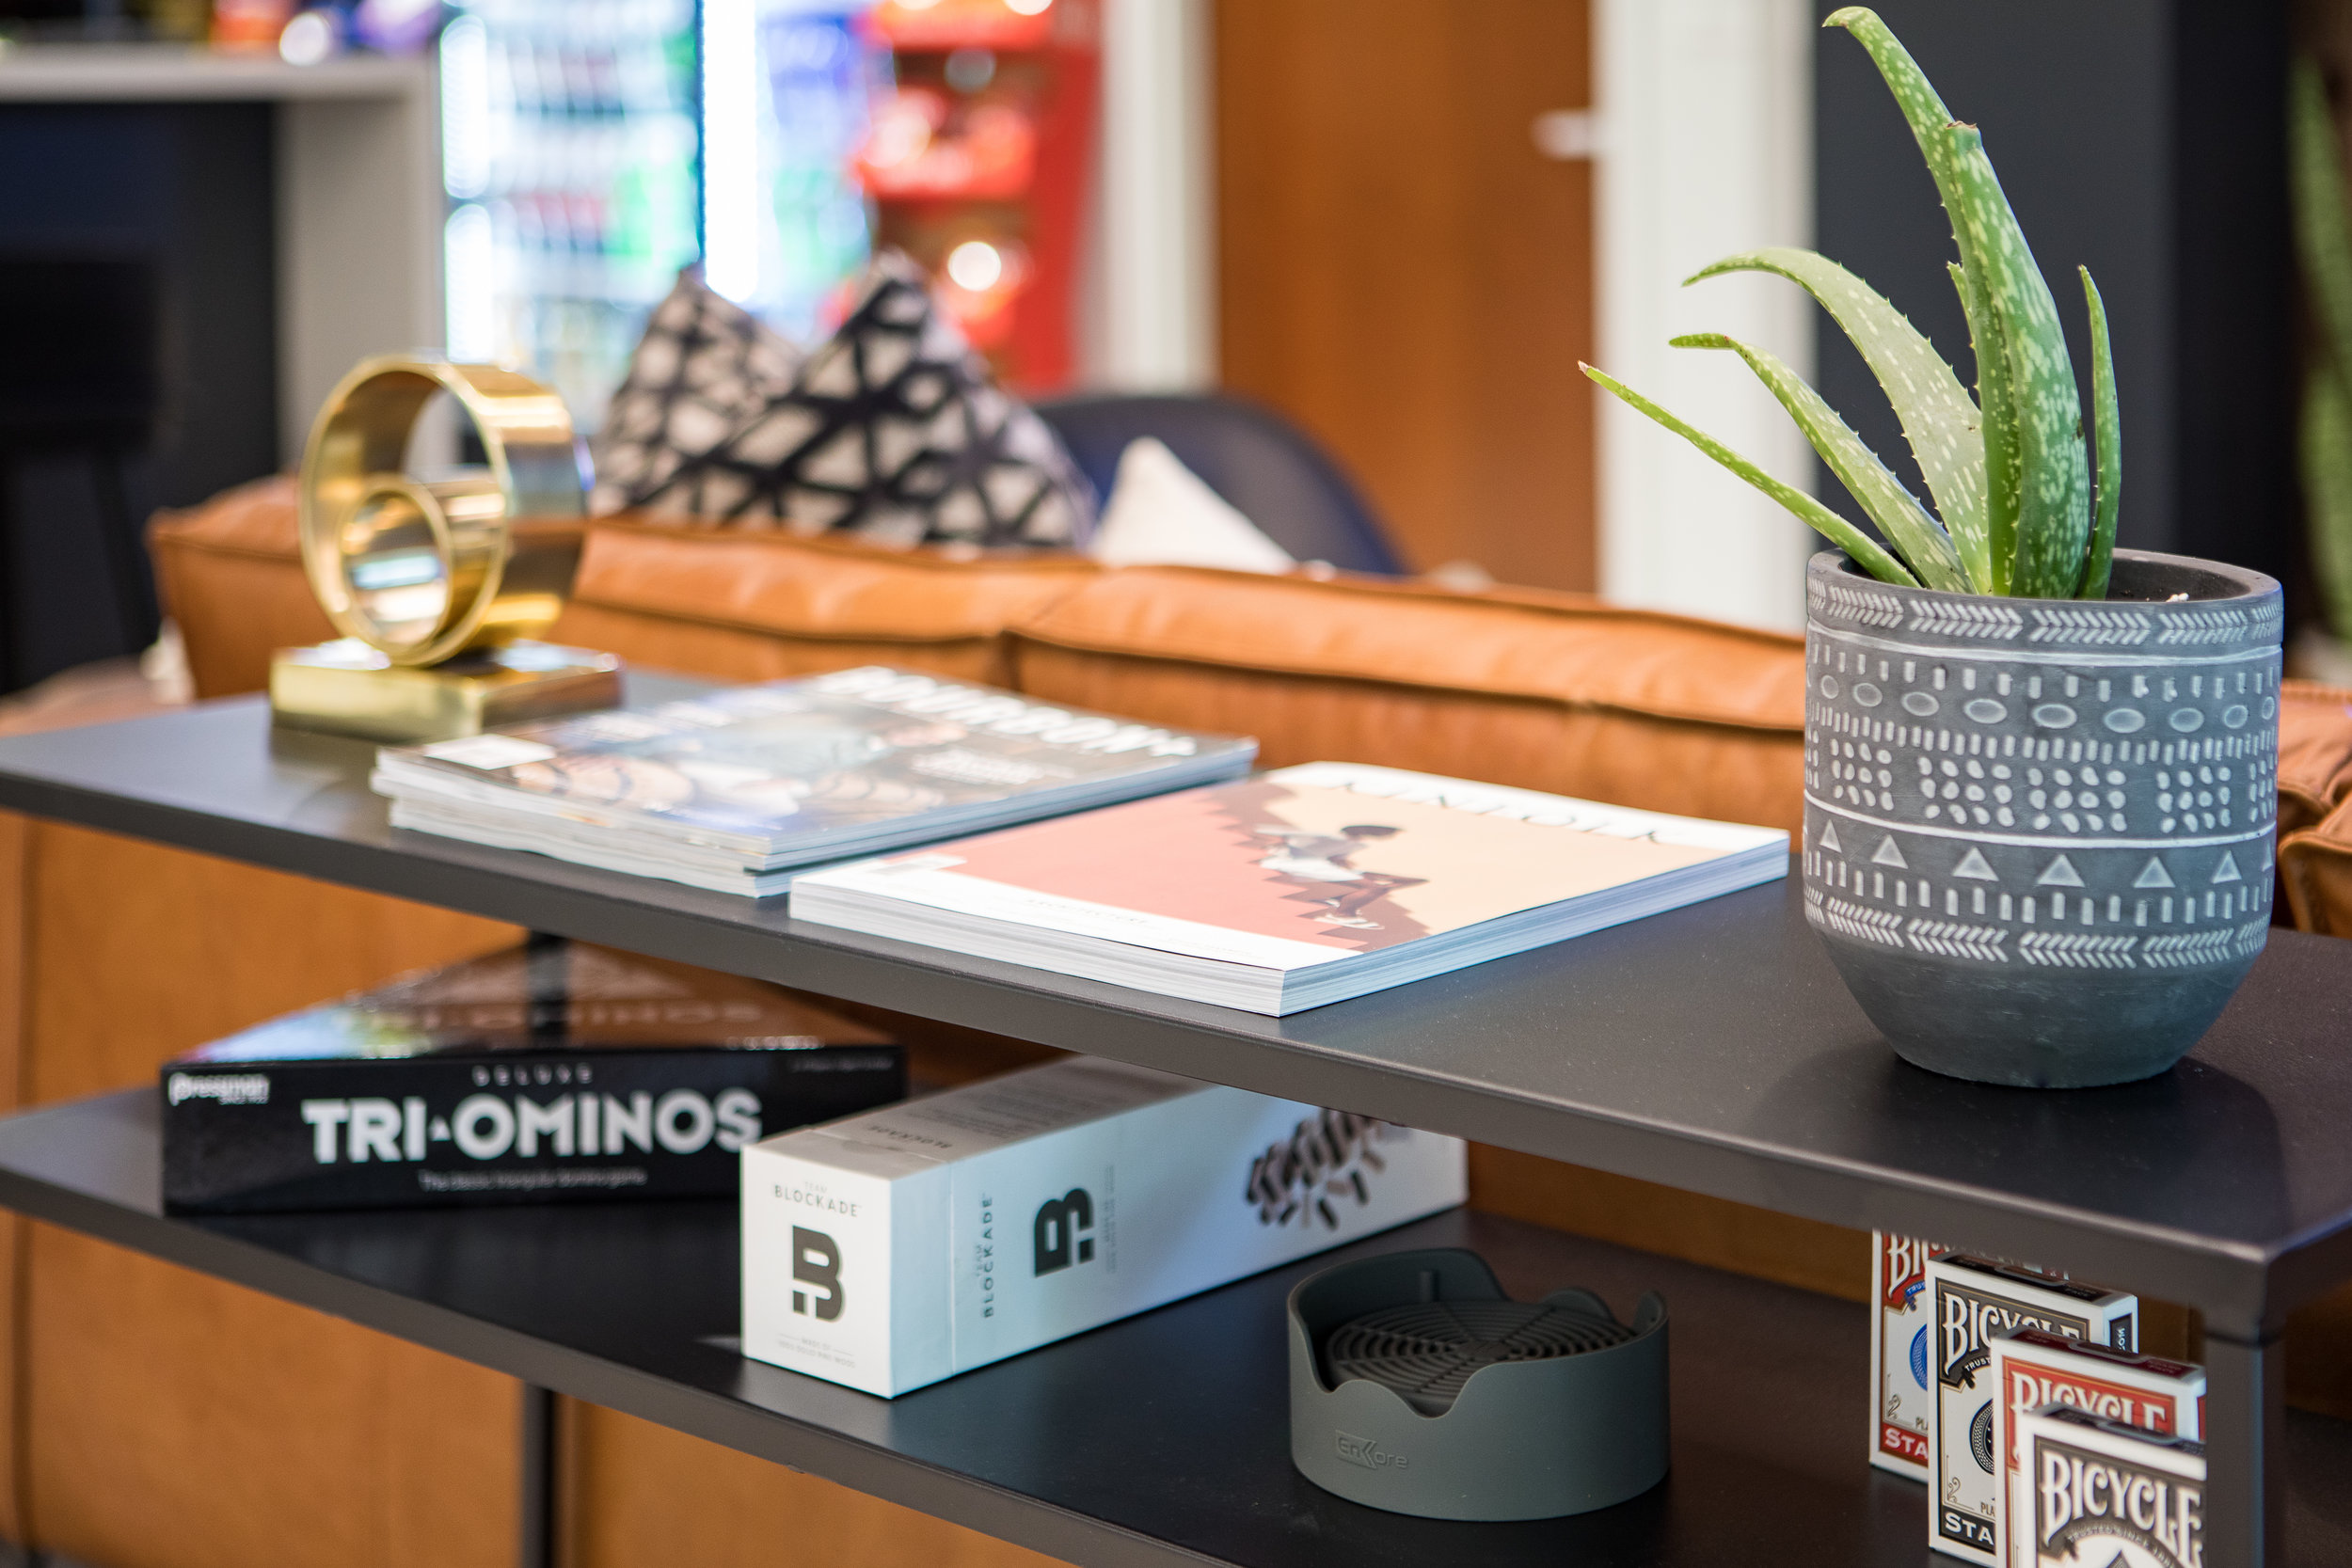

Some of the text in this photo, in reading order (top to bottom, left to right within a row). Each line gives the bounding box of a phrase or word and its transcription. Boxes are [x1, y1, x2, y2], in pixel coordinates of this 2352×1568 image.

[774, 1184, 858, 1217] BLOCKADE
[982, 1197, 993, 1319] BLOCKADE
[1945, 1511, 1994, 1545] STA
[2040, 1449, 2203, 1568] BICYCLE
